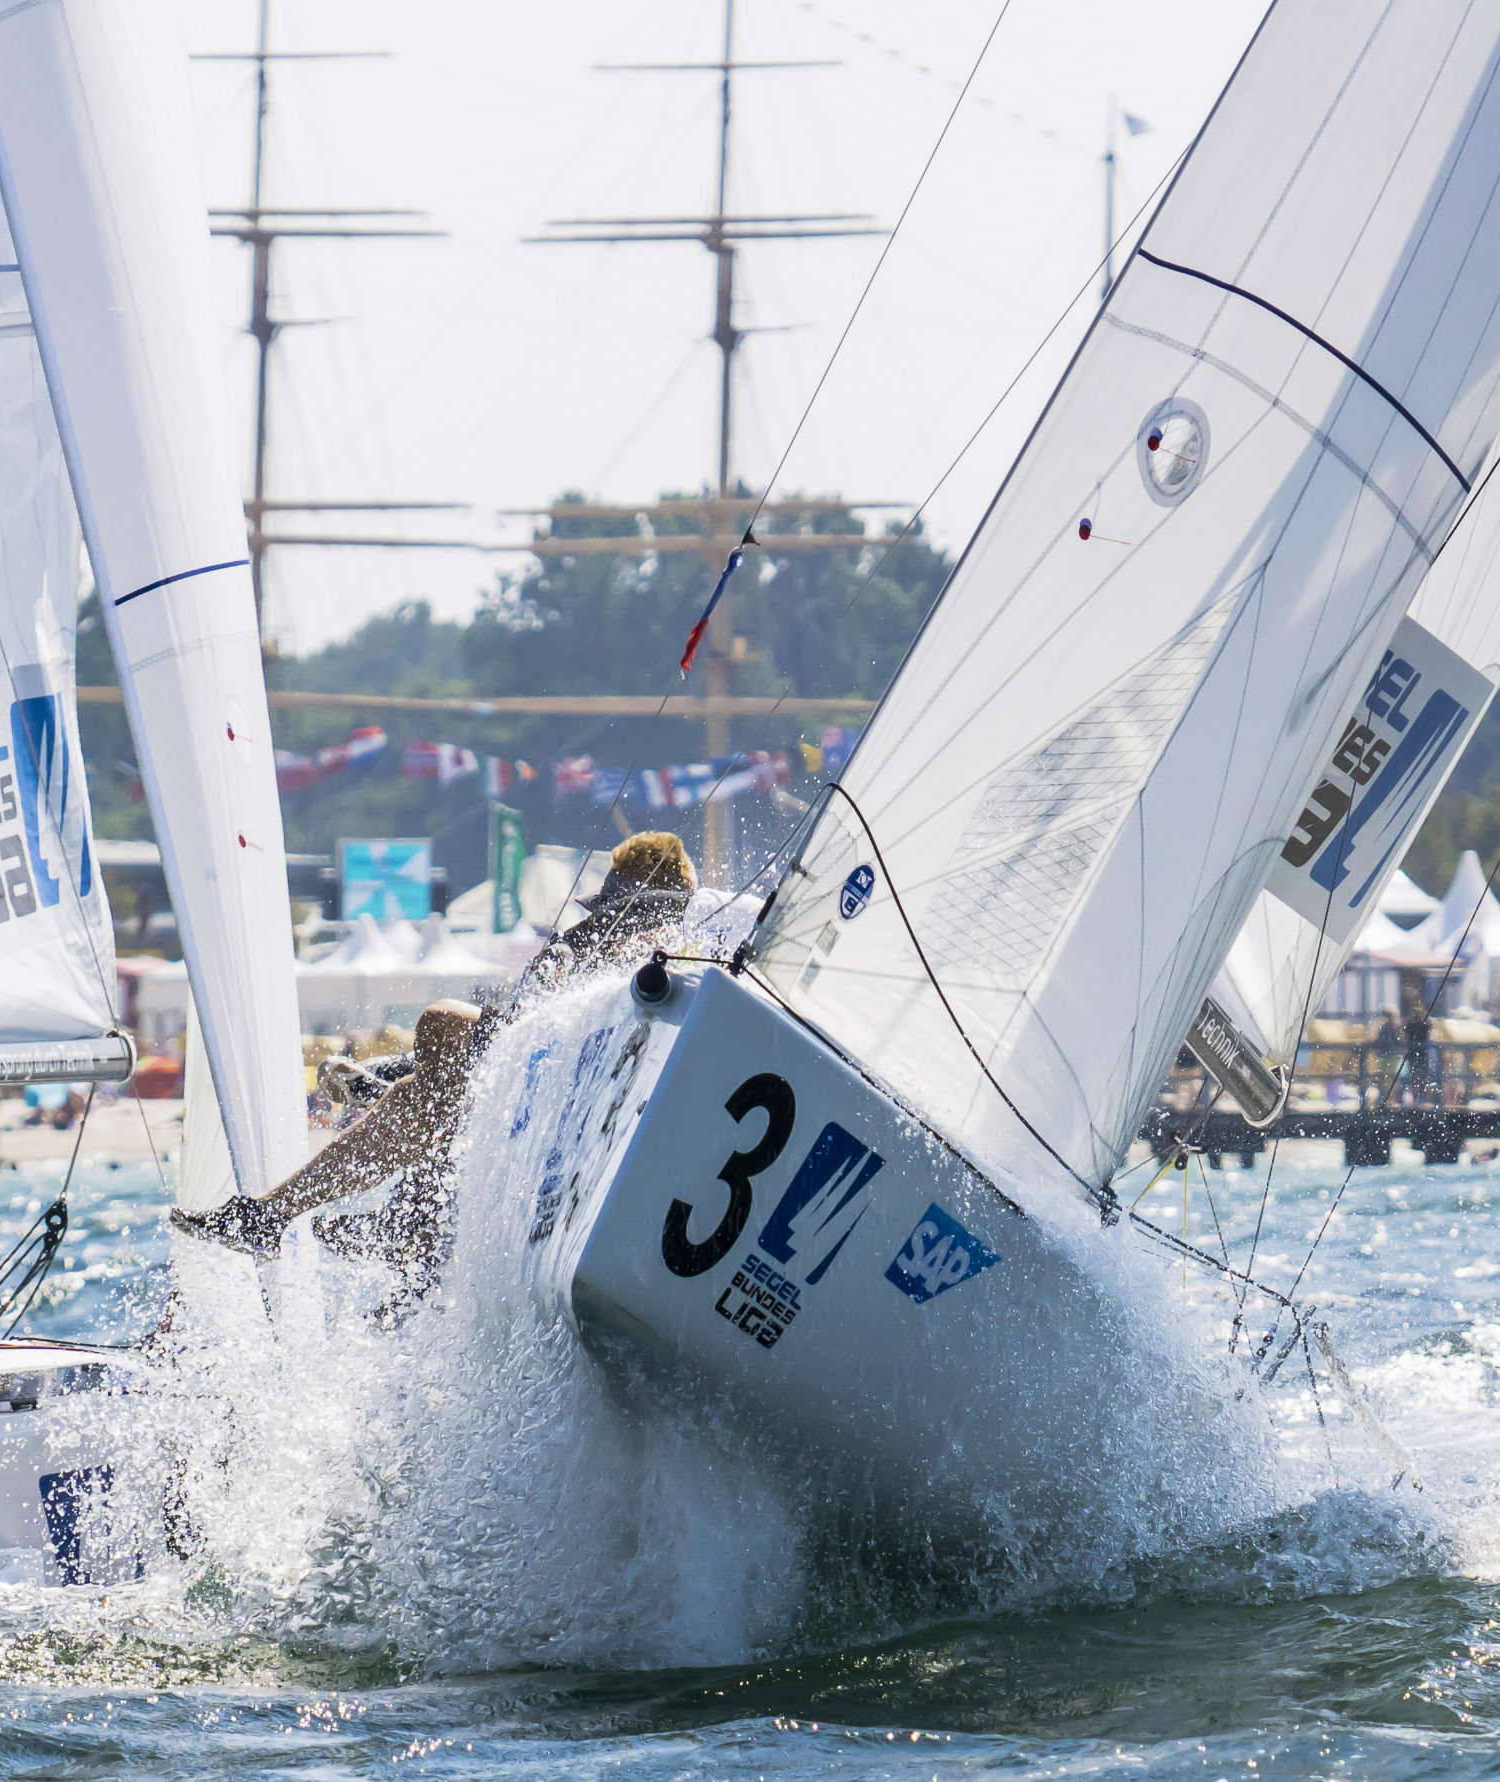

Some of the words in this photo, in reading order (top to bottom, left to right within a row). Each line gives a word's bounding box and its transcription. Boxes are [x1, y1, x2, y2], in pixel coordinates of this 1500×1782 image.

[661, 1072, 796, 1277] 3
[741, 1254, 802, 1310] SEGEL
[896, 1220, 971, 1297] SAP
[731, 1271, 796, 1326] BUNDES
